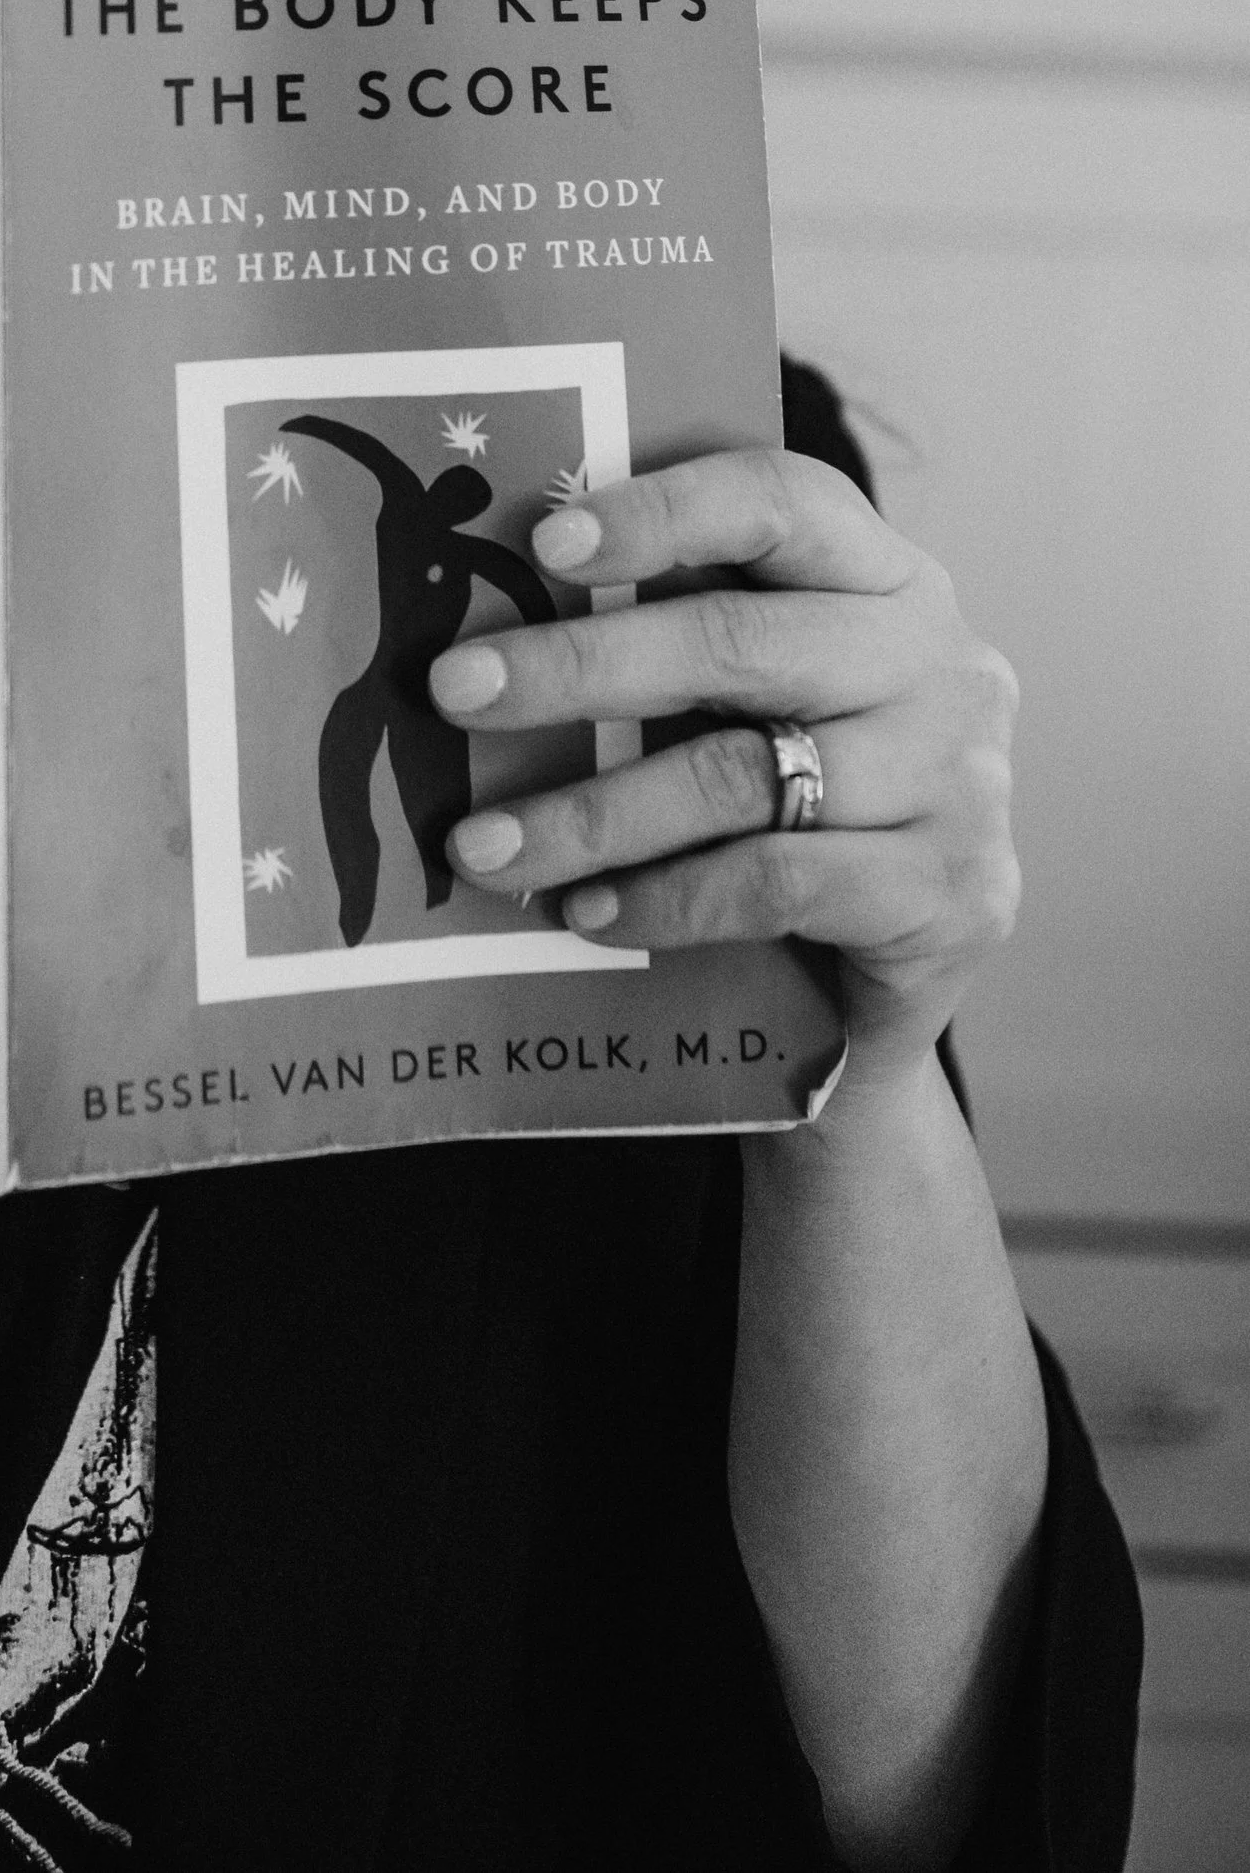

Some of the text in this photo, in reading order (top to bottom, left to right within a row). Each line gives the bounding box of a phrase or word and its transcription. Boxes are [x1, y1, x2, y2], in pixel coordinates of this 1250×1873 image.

[164, 65, 611, 126] THE SCORE
[118, 178, 663, 229] BRAIN, MIND, AND BODY
[72, 236, 713, 294] IN THE HEALING OF TRAUMA
[84, 1029, 784, 1121] BESSEL VAN DER KOLK, M.D.
